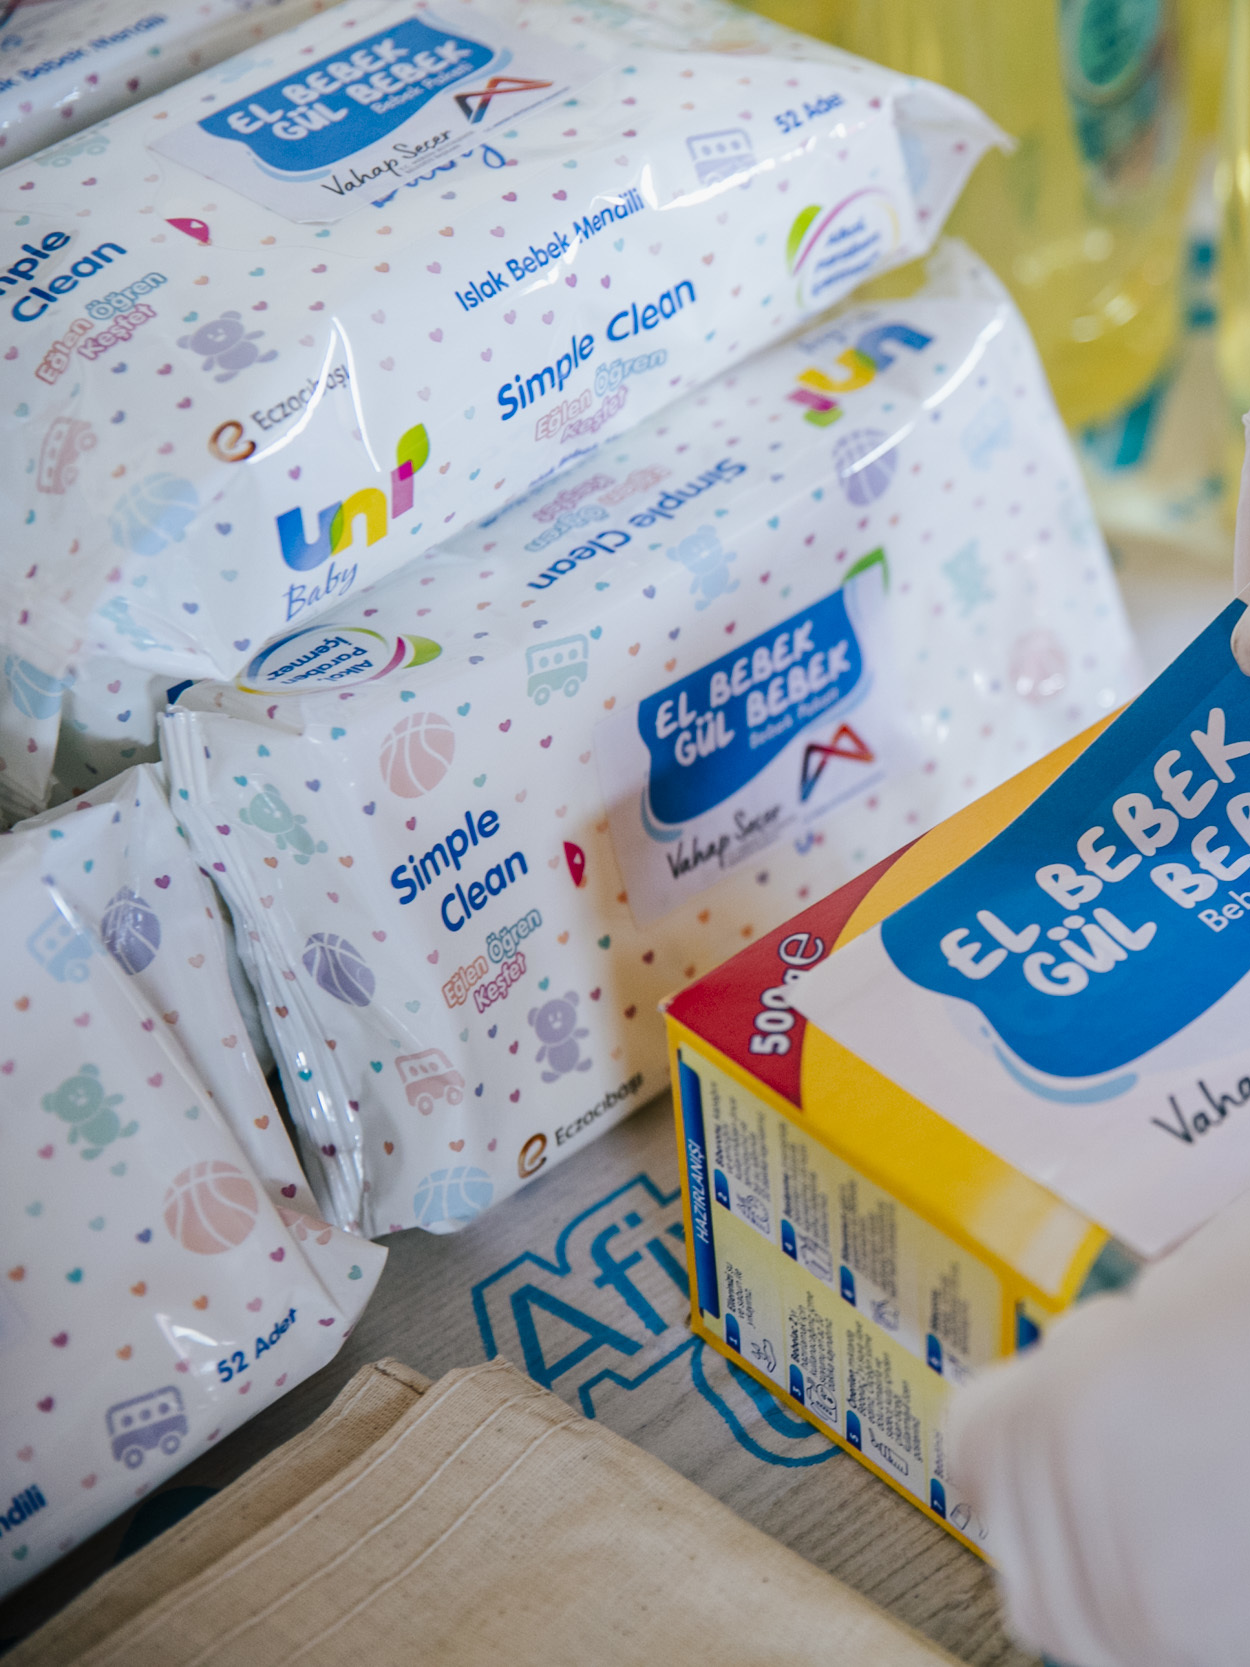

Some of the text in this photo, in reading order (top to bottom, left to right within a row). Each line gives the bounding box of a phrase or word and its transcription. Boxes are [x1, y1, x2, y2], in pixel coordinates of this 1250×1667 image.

[226, 36, 411, 135] EL BEBEK
[271, 40, 473, 141] GÜL BEBEK
[368, 86, 425, 116] Bebek
[774, 108, 804, 134] 52
[320, 157, 403, 196] Vahap
[11, 241, 128, 323] Clean
[84, 271, 170, 321] Öğren
[454, 271, 510, 312] Islak
[505, 231, 571, 283] Bebek
[75, 302, 158, 362] Keşfet
[497, 278, 697, 422] Simple Clean
[594, 347, 669, 399] Öğren
[274, 422, 430, 572] uni
[526, 457, 748, 591] Simple Clean
[280, 560, 359, 622] Baby
[280, 646, 369, 685] Paraben
[654, 618, 815, 740] EL BEBEK
[674, 639, 851, 768] GÜL BEBEK
[390, 809, 500, 906] Simple
[440, 850, 529, 933] Clean
[666, 833, 731, 881] Vahap
[440, 907, 544, 1010] Eğlen Öğren
[472, 950, 528, 1015] Keşfet
[939, 908, 1042, 981] EL
[1021, 906, 1158, 997] GÜL
[688, 1137, 709, 1245] HAZIRLANIŞI
[217, 1306, 298, 1384] 52 Adet
